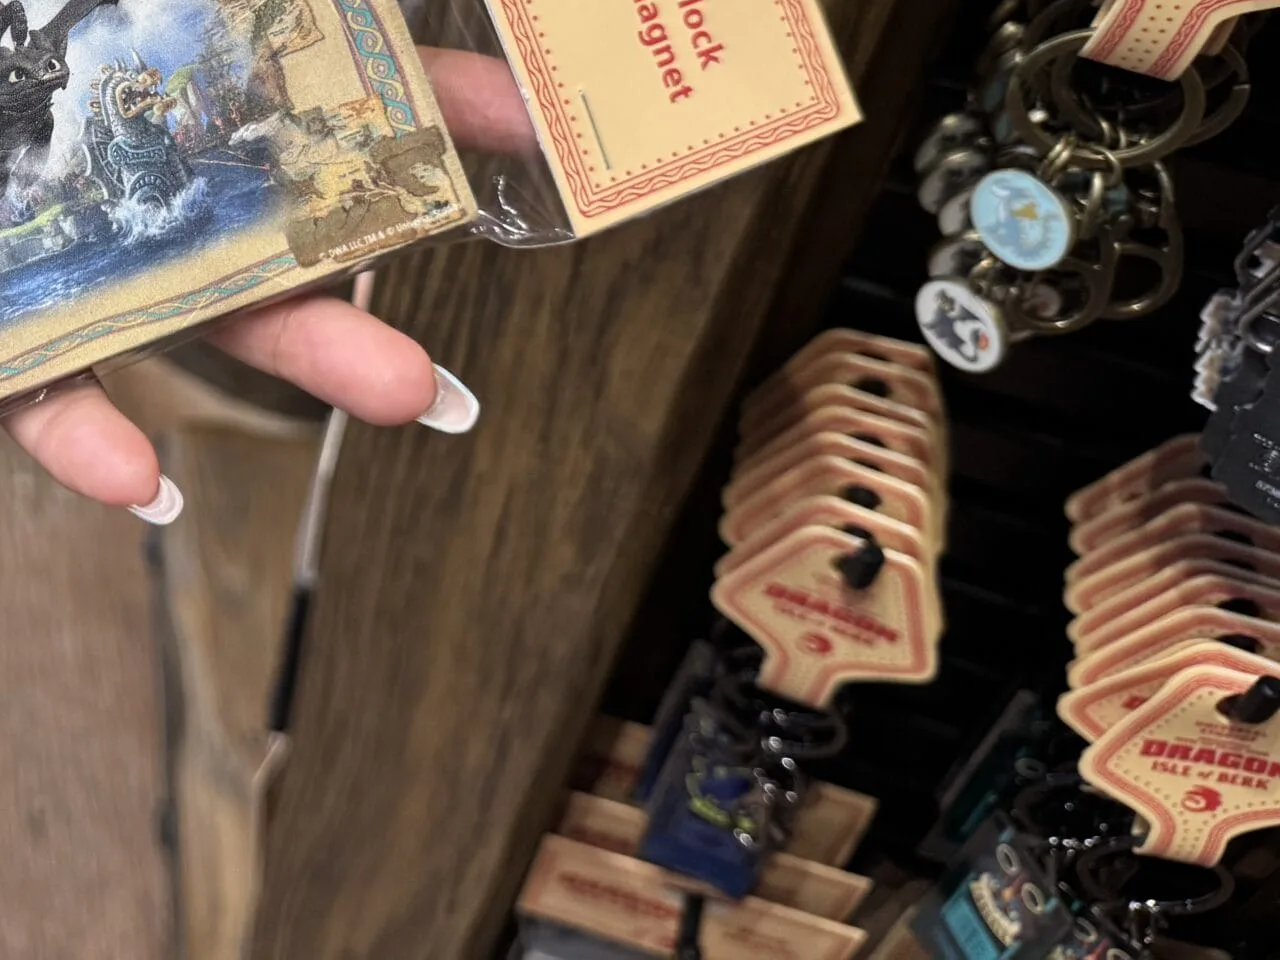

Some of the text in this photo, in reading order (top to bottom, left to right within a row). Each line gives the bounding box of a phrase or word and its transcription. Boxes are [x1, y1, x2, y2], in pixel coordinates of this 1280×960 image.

[328, 245, 349, 257] DWA
[1150, 760, 1191, 777] ISLE
[1216, 771, 1270, 790] BERK
